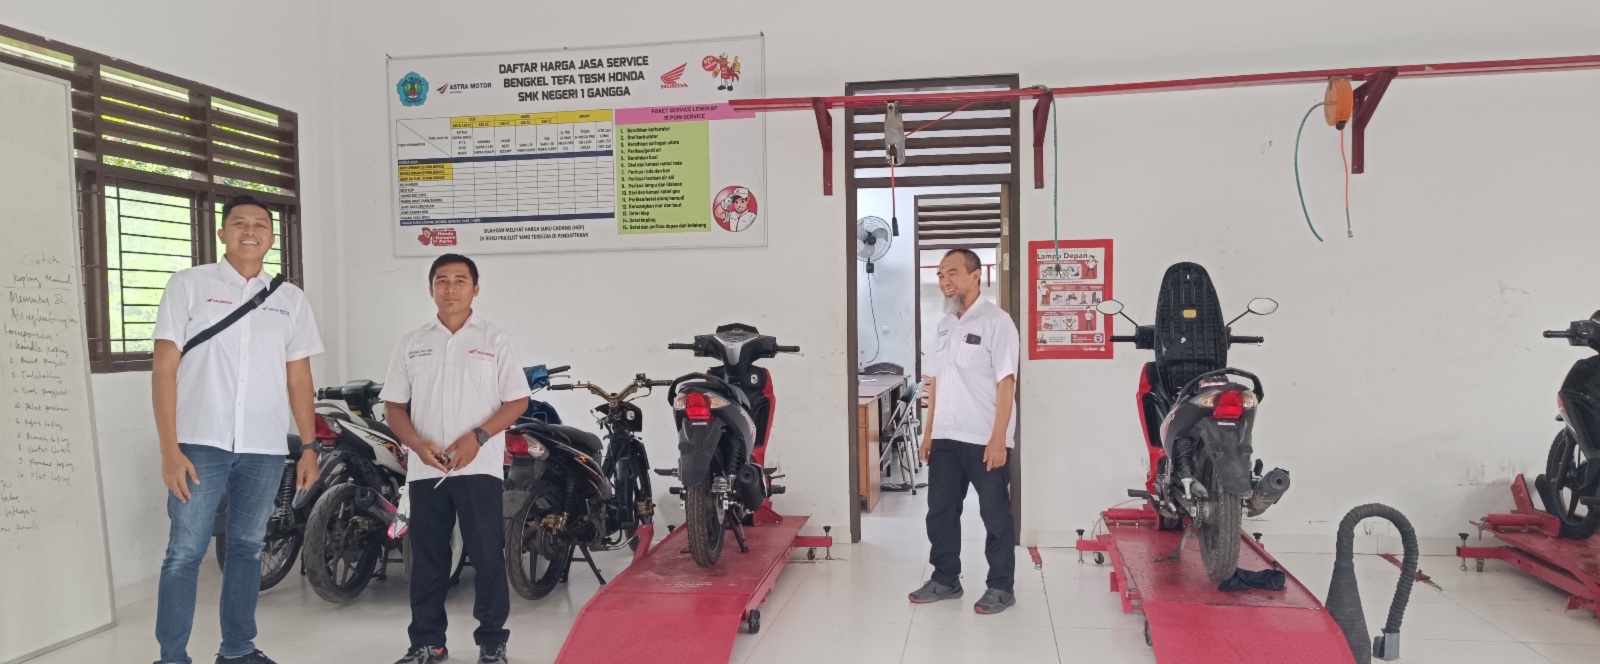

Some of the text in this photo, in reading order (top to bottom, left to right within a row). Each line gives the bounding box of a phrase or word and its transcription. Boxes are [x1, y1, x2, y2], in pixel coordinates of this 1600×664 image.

[499, 56, 649, 74] DAFTAR HARGA JASA SERVICE
[504, 70, 645, 88] BENGKEL TEFA TBSM HONDA
[518, 86, 630, 102] SMK NEGERI 1 GANGGA
[21, 254, 60, 265] Clutch
